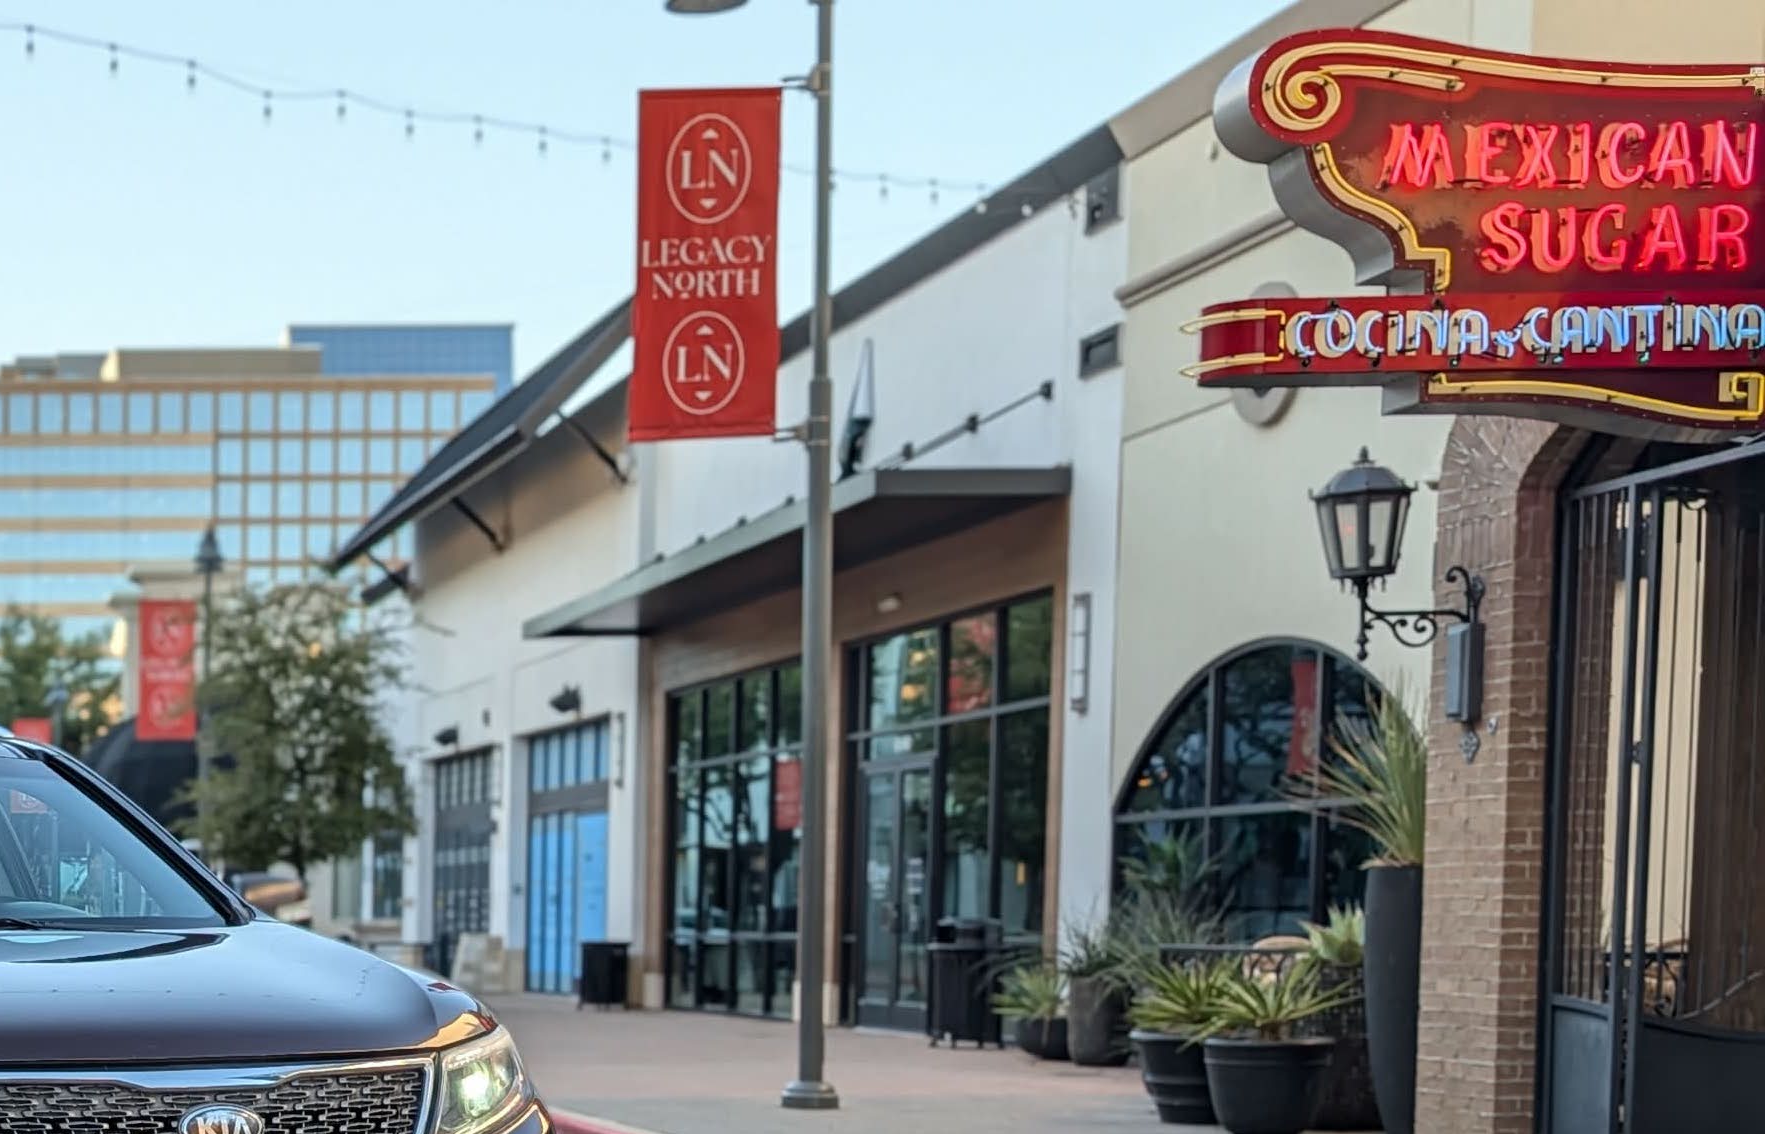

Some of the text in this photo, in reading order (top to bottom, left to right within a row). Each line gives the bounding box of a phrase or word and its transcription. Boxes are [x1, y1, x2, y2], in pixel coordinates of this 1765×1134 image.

[680, 148, 739, 190] LN
[1375, 120, 1757, 190] MEXICAN
[641, 234, 771, 268] LEGACY
[1480, 202, 1750, 273] SUGAR
[651, 268, 761, 300] NORTH
[1285, 308, 1488, 359] COCINA
[1522, 304, 1765, 355] CANTINA
[676, 343, 734, 384] LN
